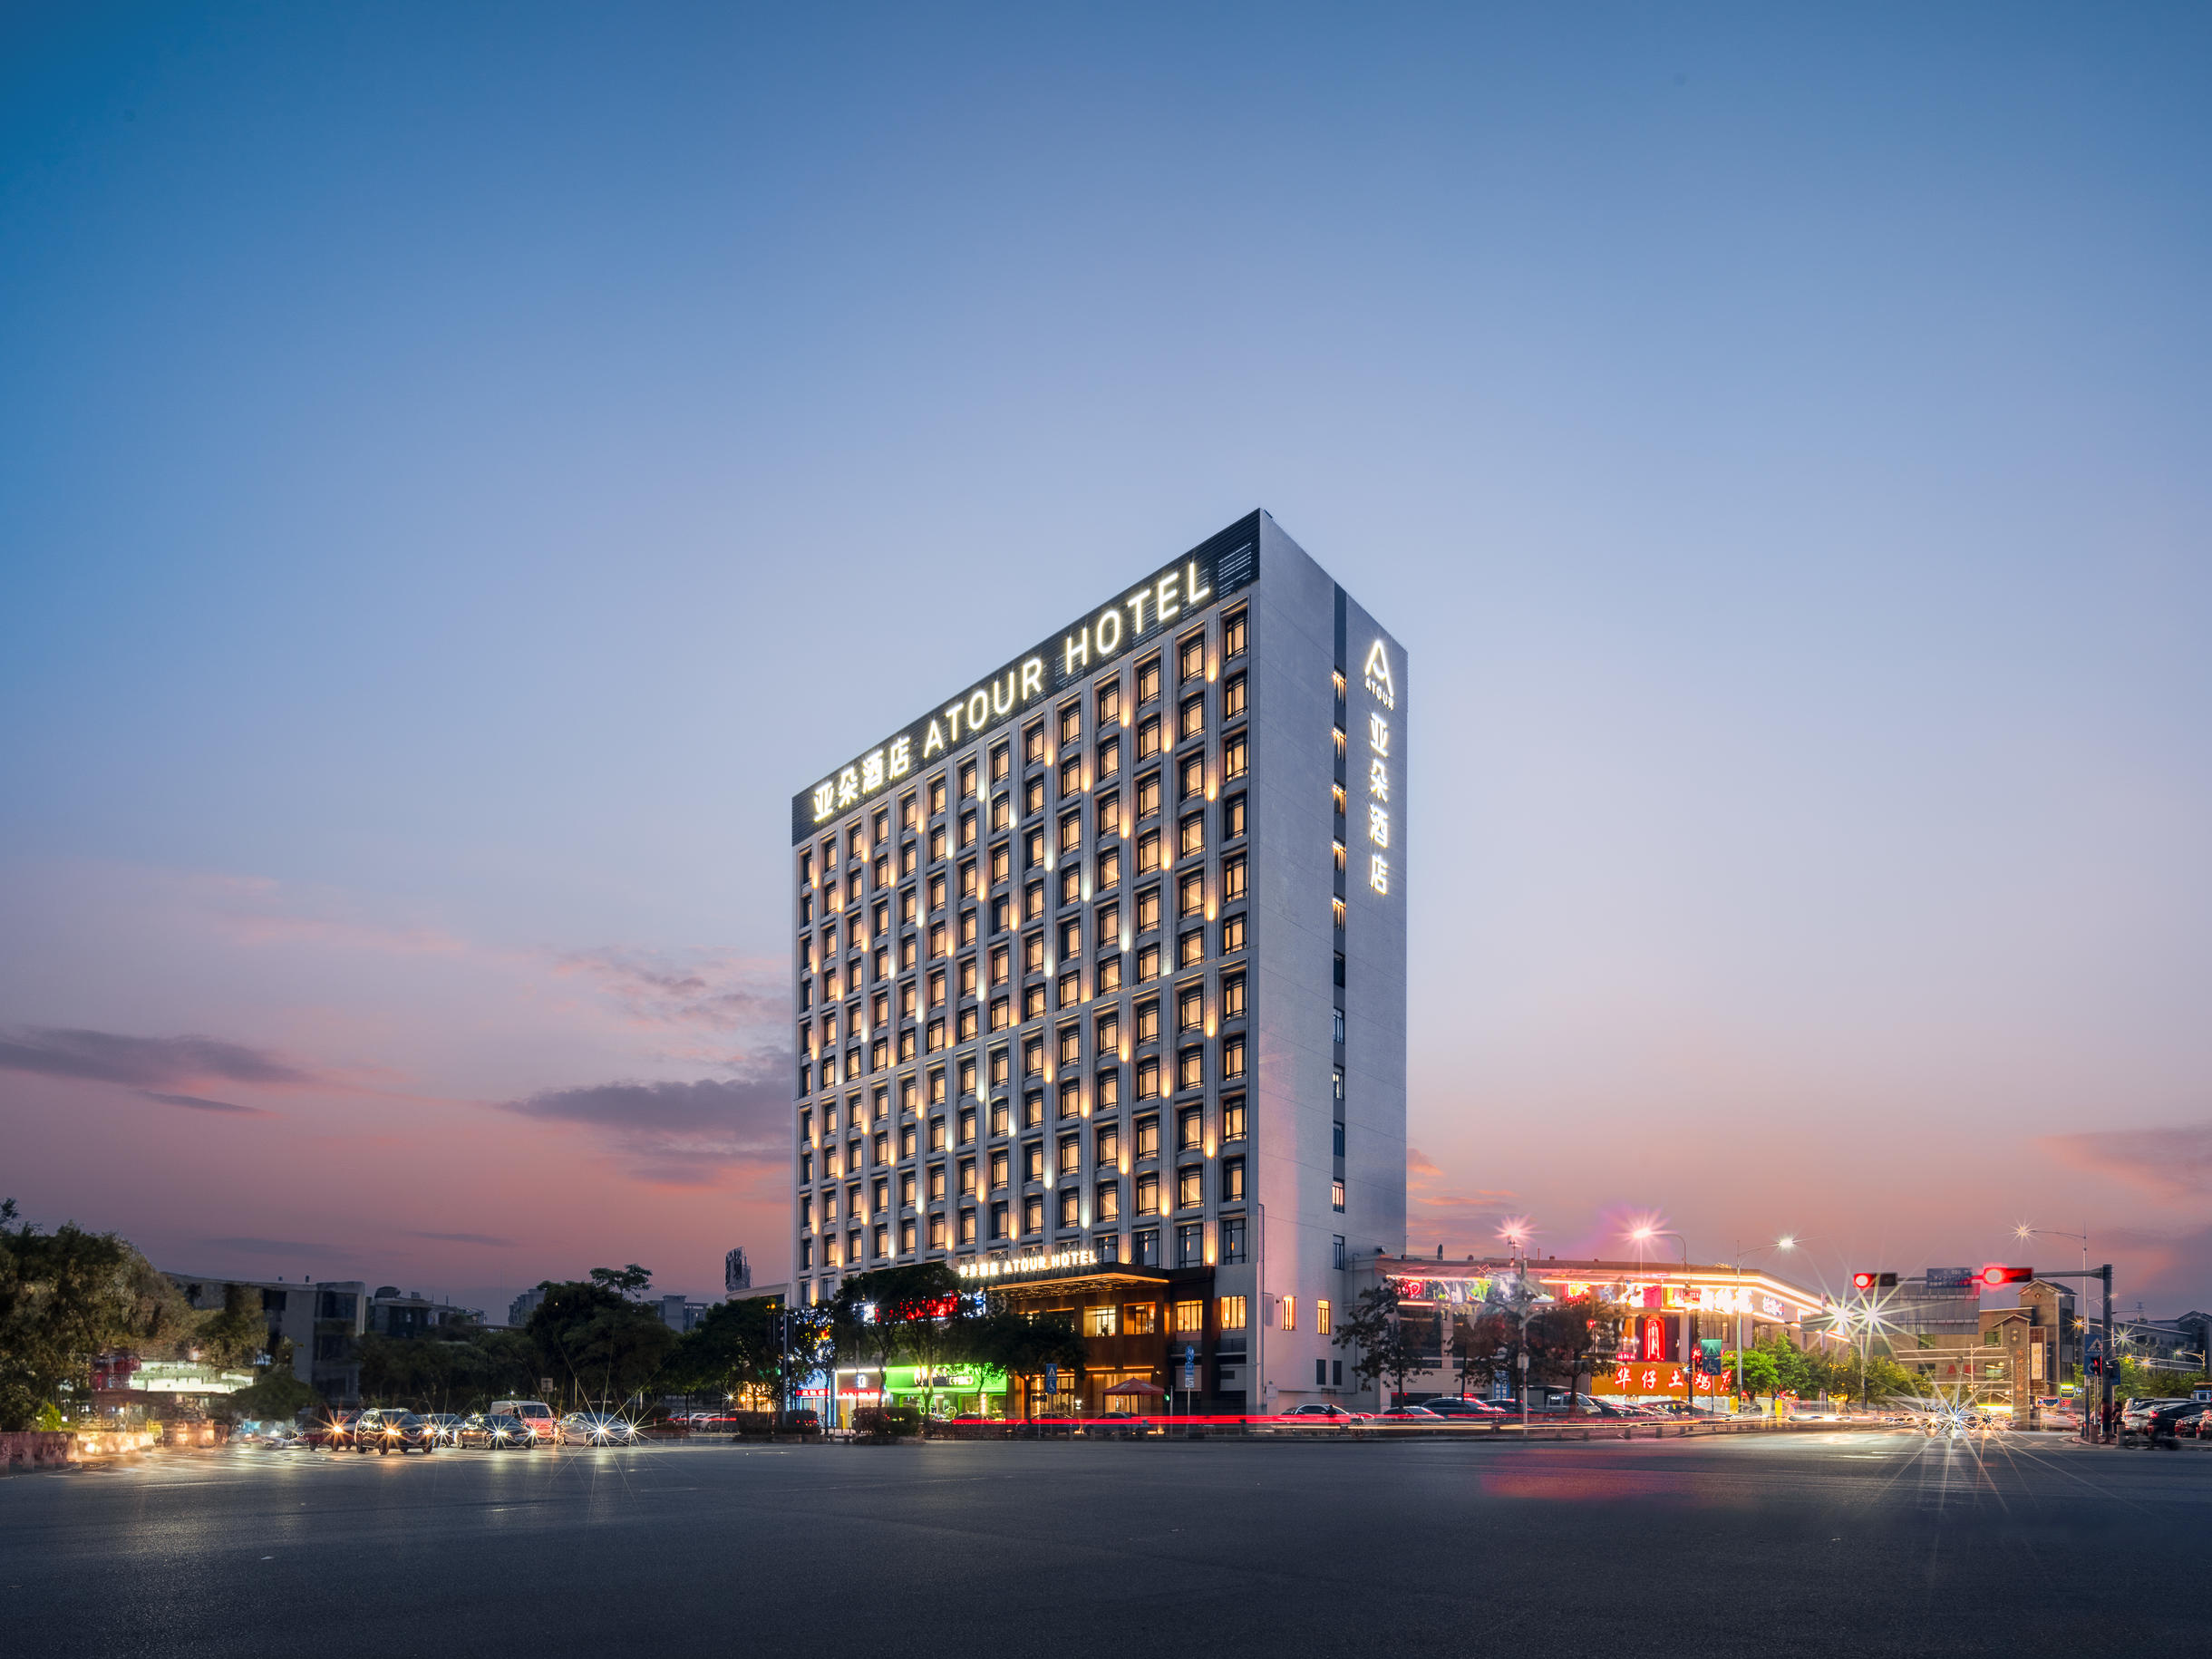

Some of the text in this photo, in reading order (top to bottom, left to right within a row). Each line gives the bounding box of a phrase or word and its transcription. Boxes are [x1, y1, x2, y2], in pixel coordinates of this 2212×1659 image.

[813, 559, 1210, 822] 亚朵酒店 ATOUR HOTEL
[1364, 675, 1394, 711] ATOUR
[1370, 712, 1389, 895] 亚朵酒店
[1003, 1256, 1046, 1274] ATOUR
[1051, 1250, 1097, 1267] HOTEL
